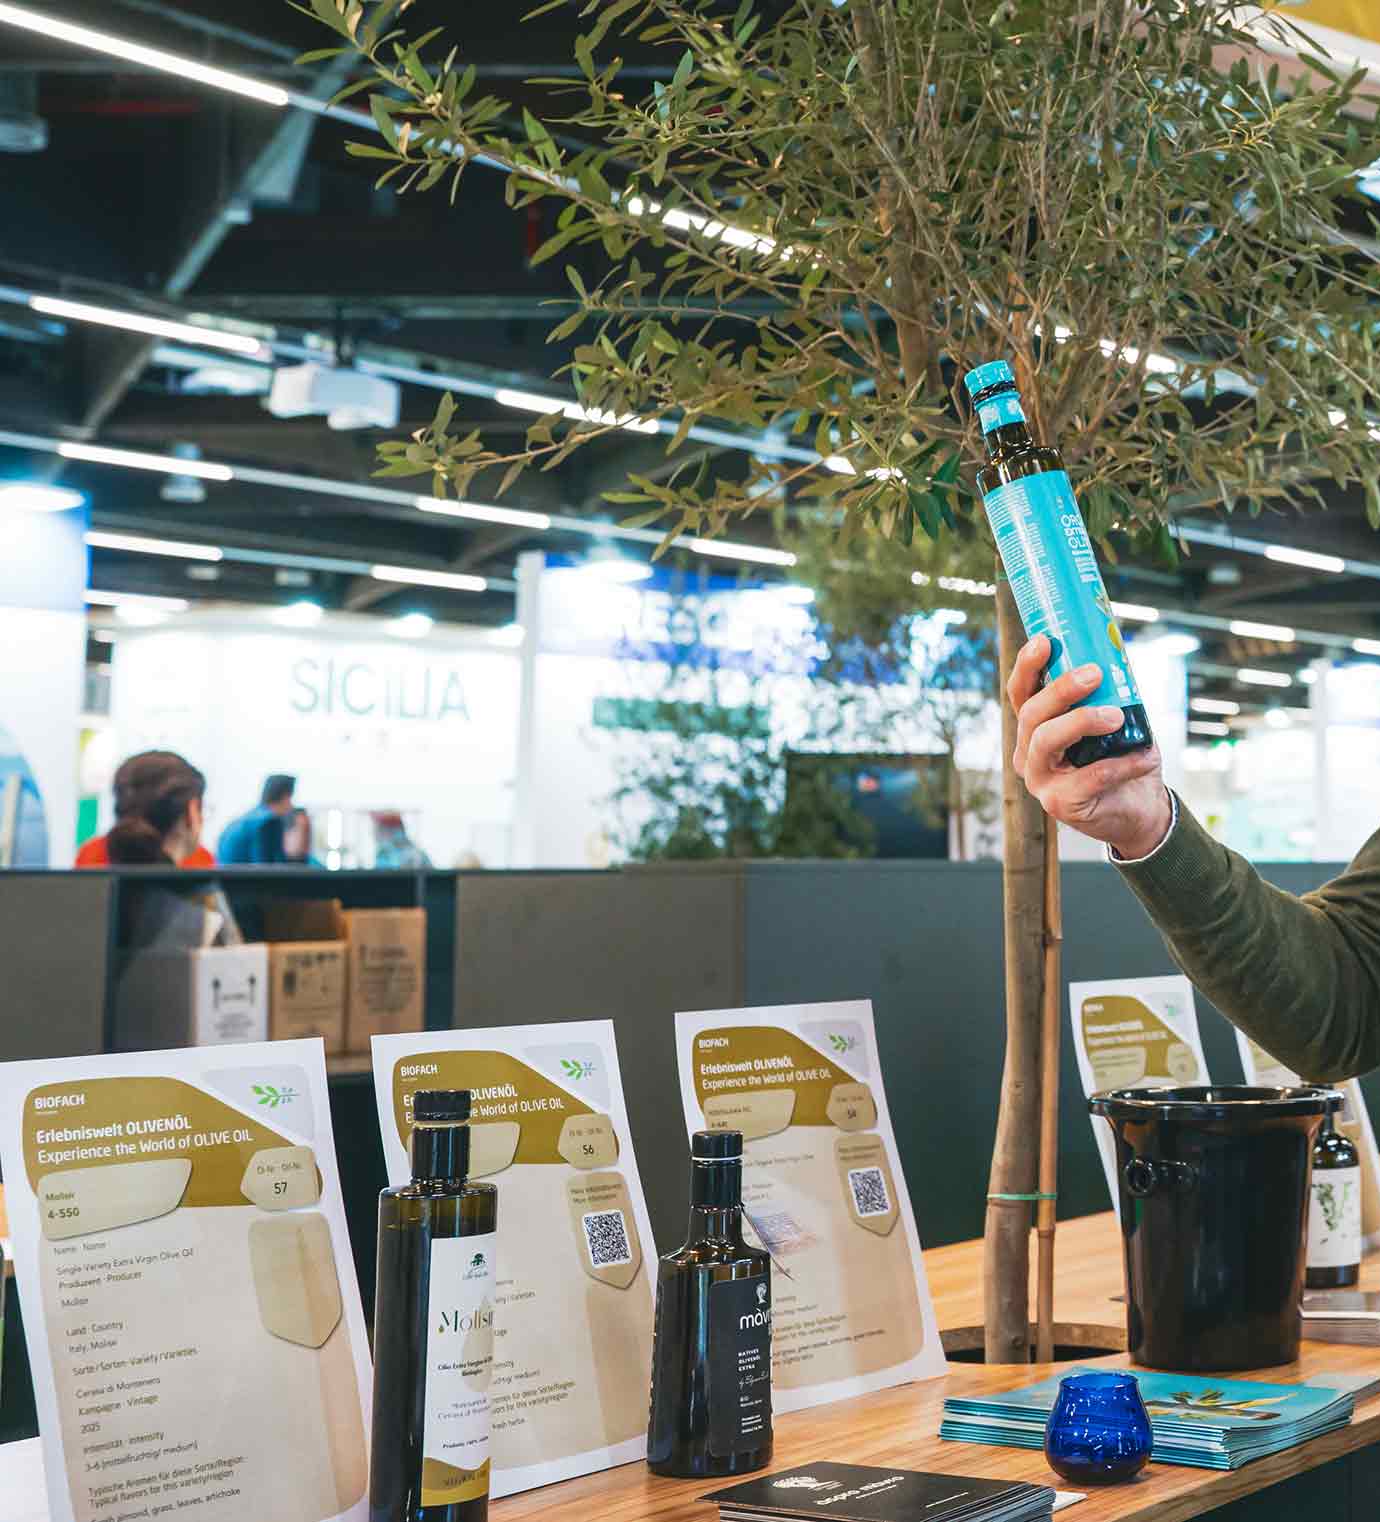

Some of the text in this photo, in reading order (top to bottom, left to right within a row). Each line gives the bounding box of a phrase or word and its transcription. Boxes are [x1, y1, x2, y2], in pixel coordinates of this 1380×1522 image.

[291, 657, 471, 720] SICILIA
[698, 1037, 729, 1049] BIOFACH
[401, 1064, 437, 1077] BIOFACH
[702, 1067, 832, 1091] Experience the World of OLIVE OIL
[34, 1093, 85, 1110] BIOFACH
[480, 1103, 506, 1117] World
[509, 1102, 518, 1112] of
[520, 1099, 547, 1112] OLIVE
[550, 1098, 565, 1110] OIL
[36, 1113, 192, 1144] Erlebniswelt OLIVENÖL
[38, 1128, 253, 1165] Experience the World of OLIVE OIL
[583, 1144, 594, 1155] 56
[274, 1182, 288, 1194] 57
[135, 1255, 159, 1266] Virgin
